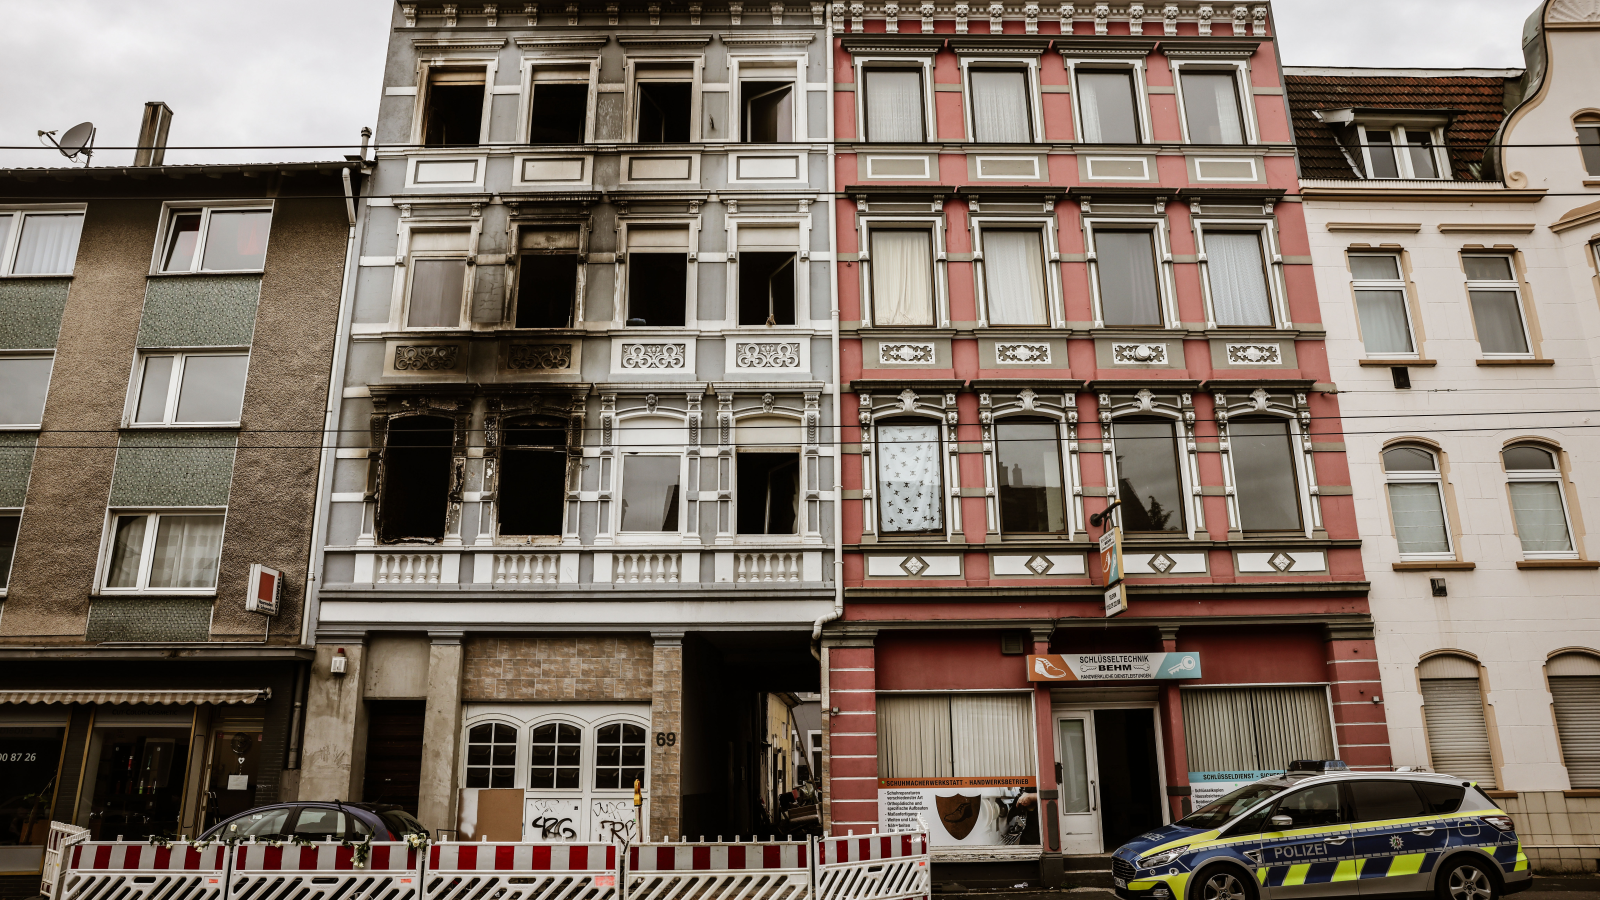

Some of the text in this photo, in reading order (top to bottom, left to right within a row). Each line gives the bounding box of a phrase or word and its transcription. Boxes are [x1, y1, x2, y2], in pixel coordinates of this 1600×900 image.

[1080, 655, 1149, 663] SCHLÜSSELTECHNIK
[656, 732, 676, 746] 69
[10, 752, 22, 762] 87
[24, 752, 37, 762] 26
[1203, 772, 1254, 780] SCHLÜSSELDIENST
[886, 779, 963, 787] SCHUHMACHERWERKSTATT
[969, 778, 1029, 786] HANDWERKSBETRIEB
[1274, 843, 1328, 859] POLIZEI
